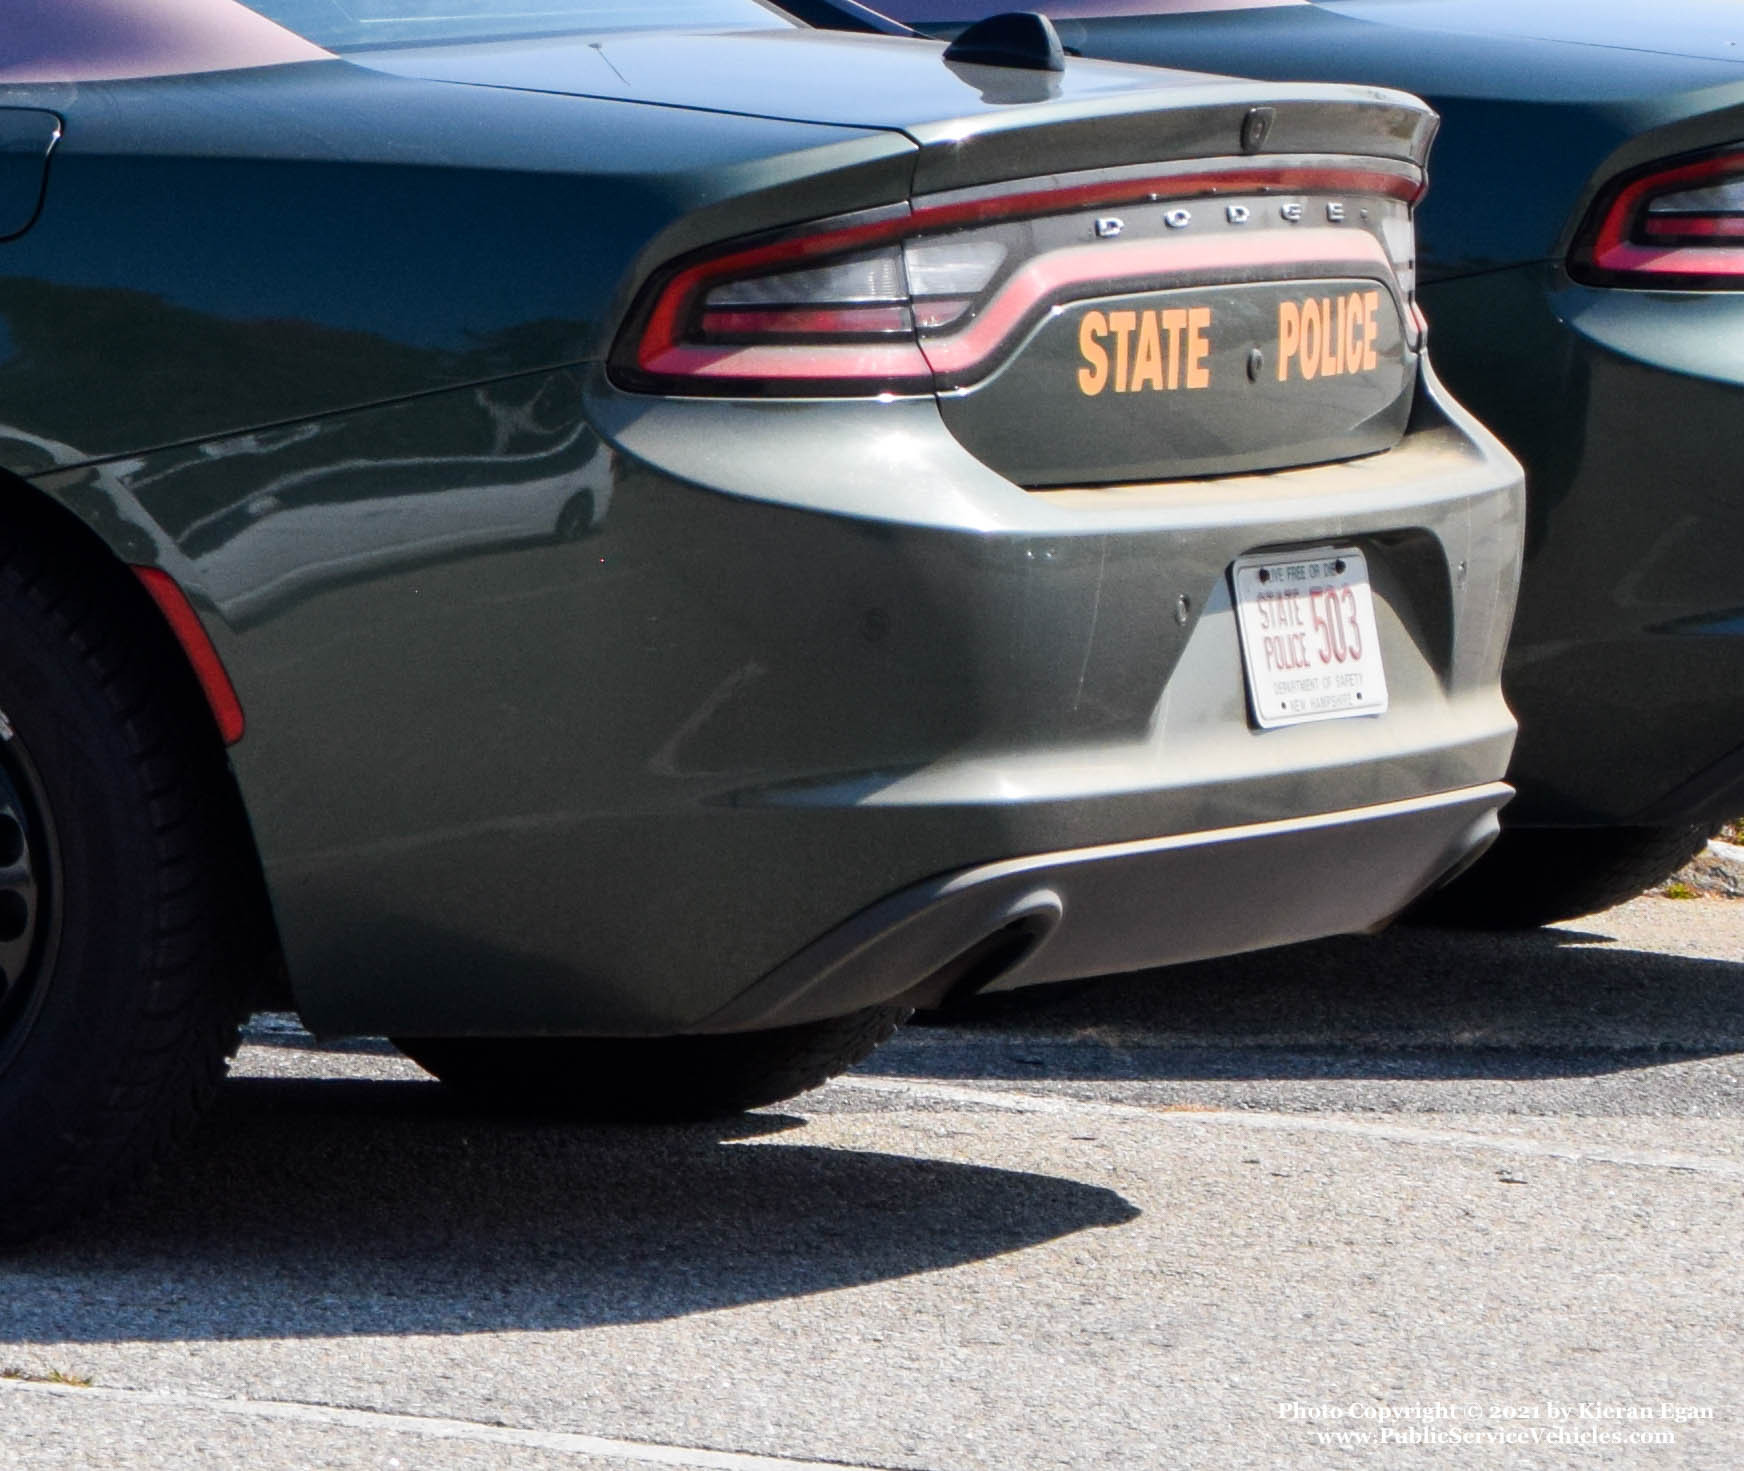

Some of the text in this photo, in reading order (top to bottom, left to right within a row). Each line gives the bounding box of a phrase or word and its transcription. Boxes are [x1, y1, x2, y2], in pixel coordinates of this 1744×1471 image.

[1096, 201, 1344, 238] DODGE
[1078, 291, 1379, 396] STATE POLICE
[1287, 565, 1306, 581] FREE
[1257, 583, 1362, 664] STATE 503
[1263, 632, 1311, 671] POLICE
